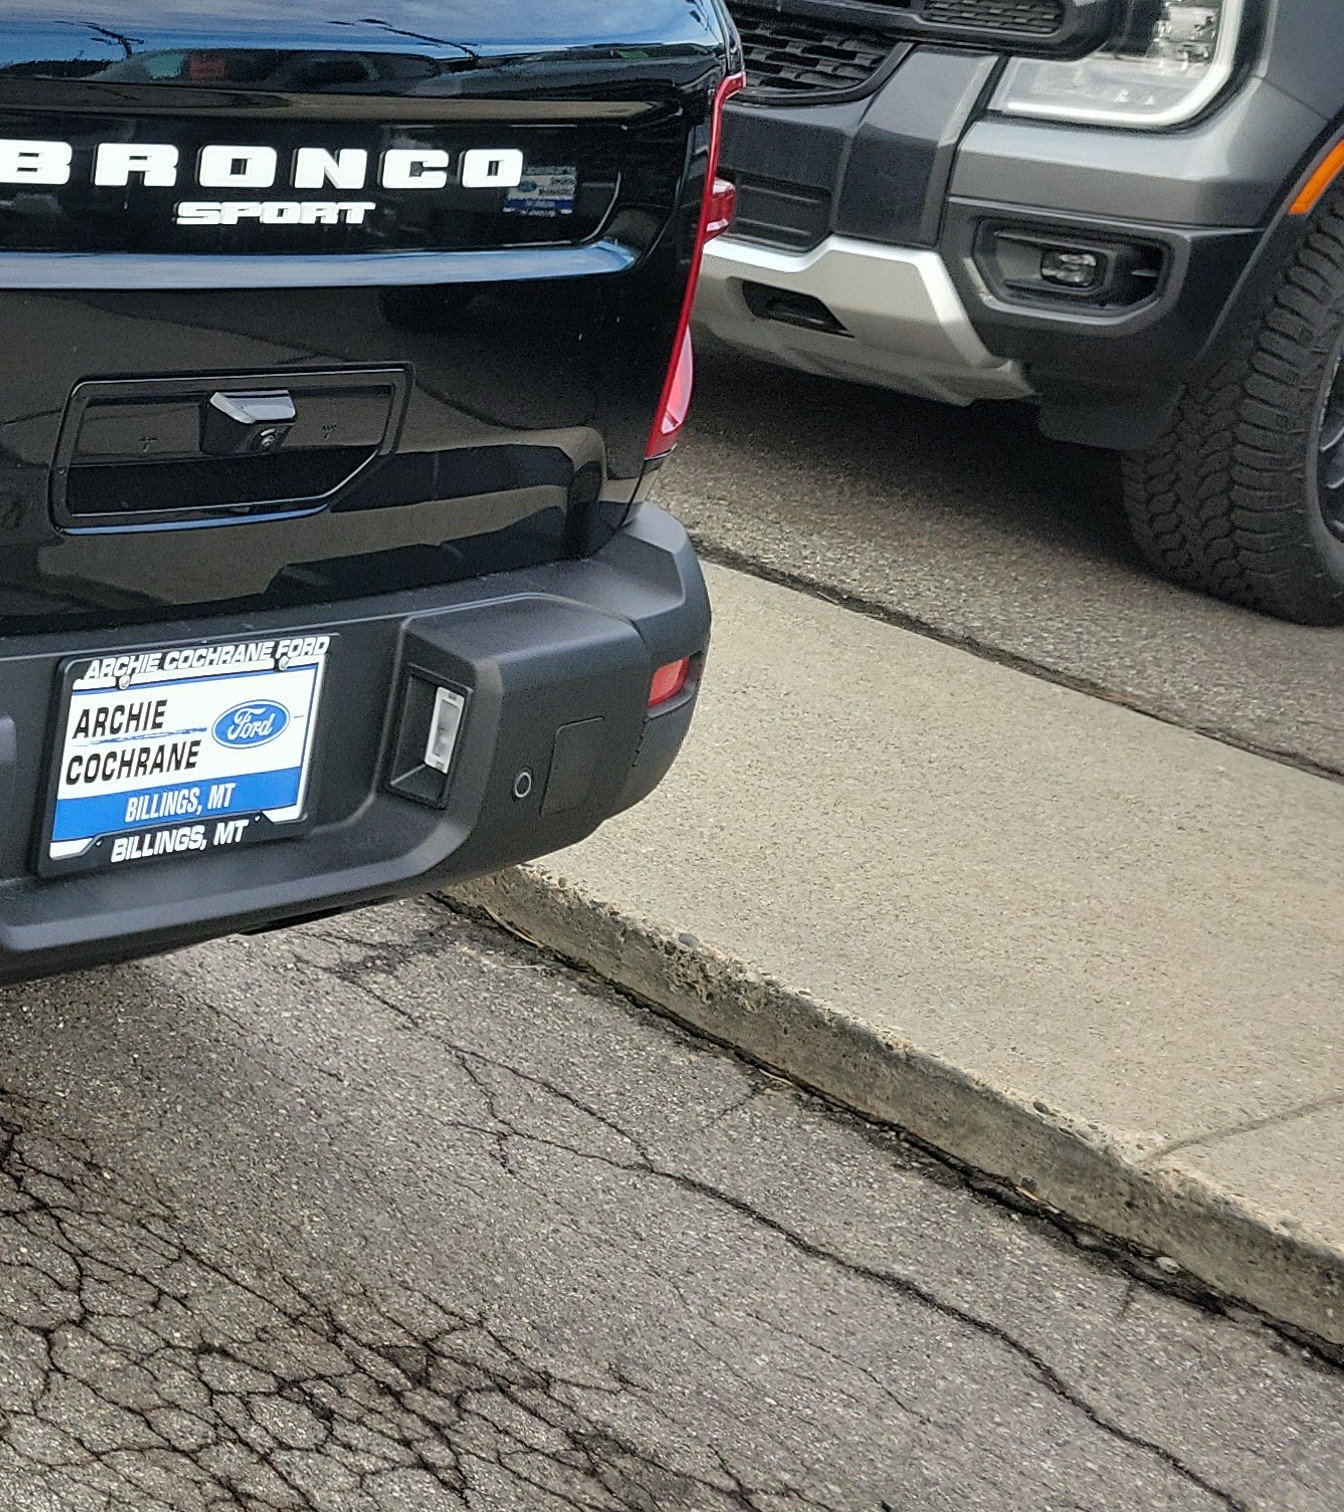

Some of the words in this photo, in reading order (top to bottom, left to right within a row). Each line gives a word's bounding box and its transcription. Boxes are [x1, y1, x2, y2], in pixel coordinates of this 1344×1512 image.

[175, 201, 376, 226] SPORT
[83, 652, 162, 681] ARCHIE
[163, 642, 275, 671] COCHRANE
[274, 636, 331, 661] FORD
[72, 699, 168, 740] ARCHIE
[226, 707, 276, 741] Ford
[65, 739, 202, 786] COCHRANE
[124, 787, 203, 823] BILLINGS,
[206, 782, 237, 810] MT
[110, 824, 207, 863] BILLINGS,
[213, 819, 250, 846] MT
